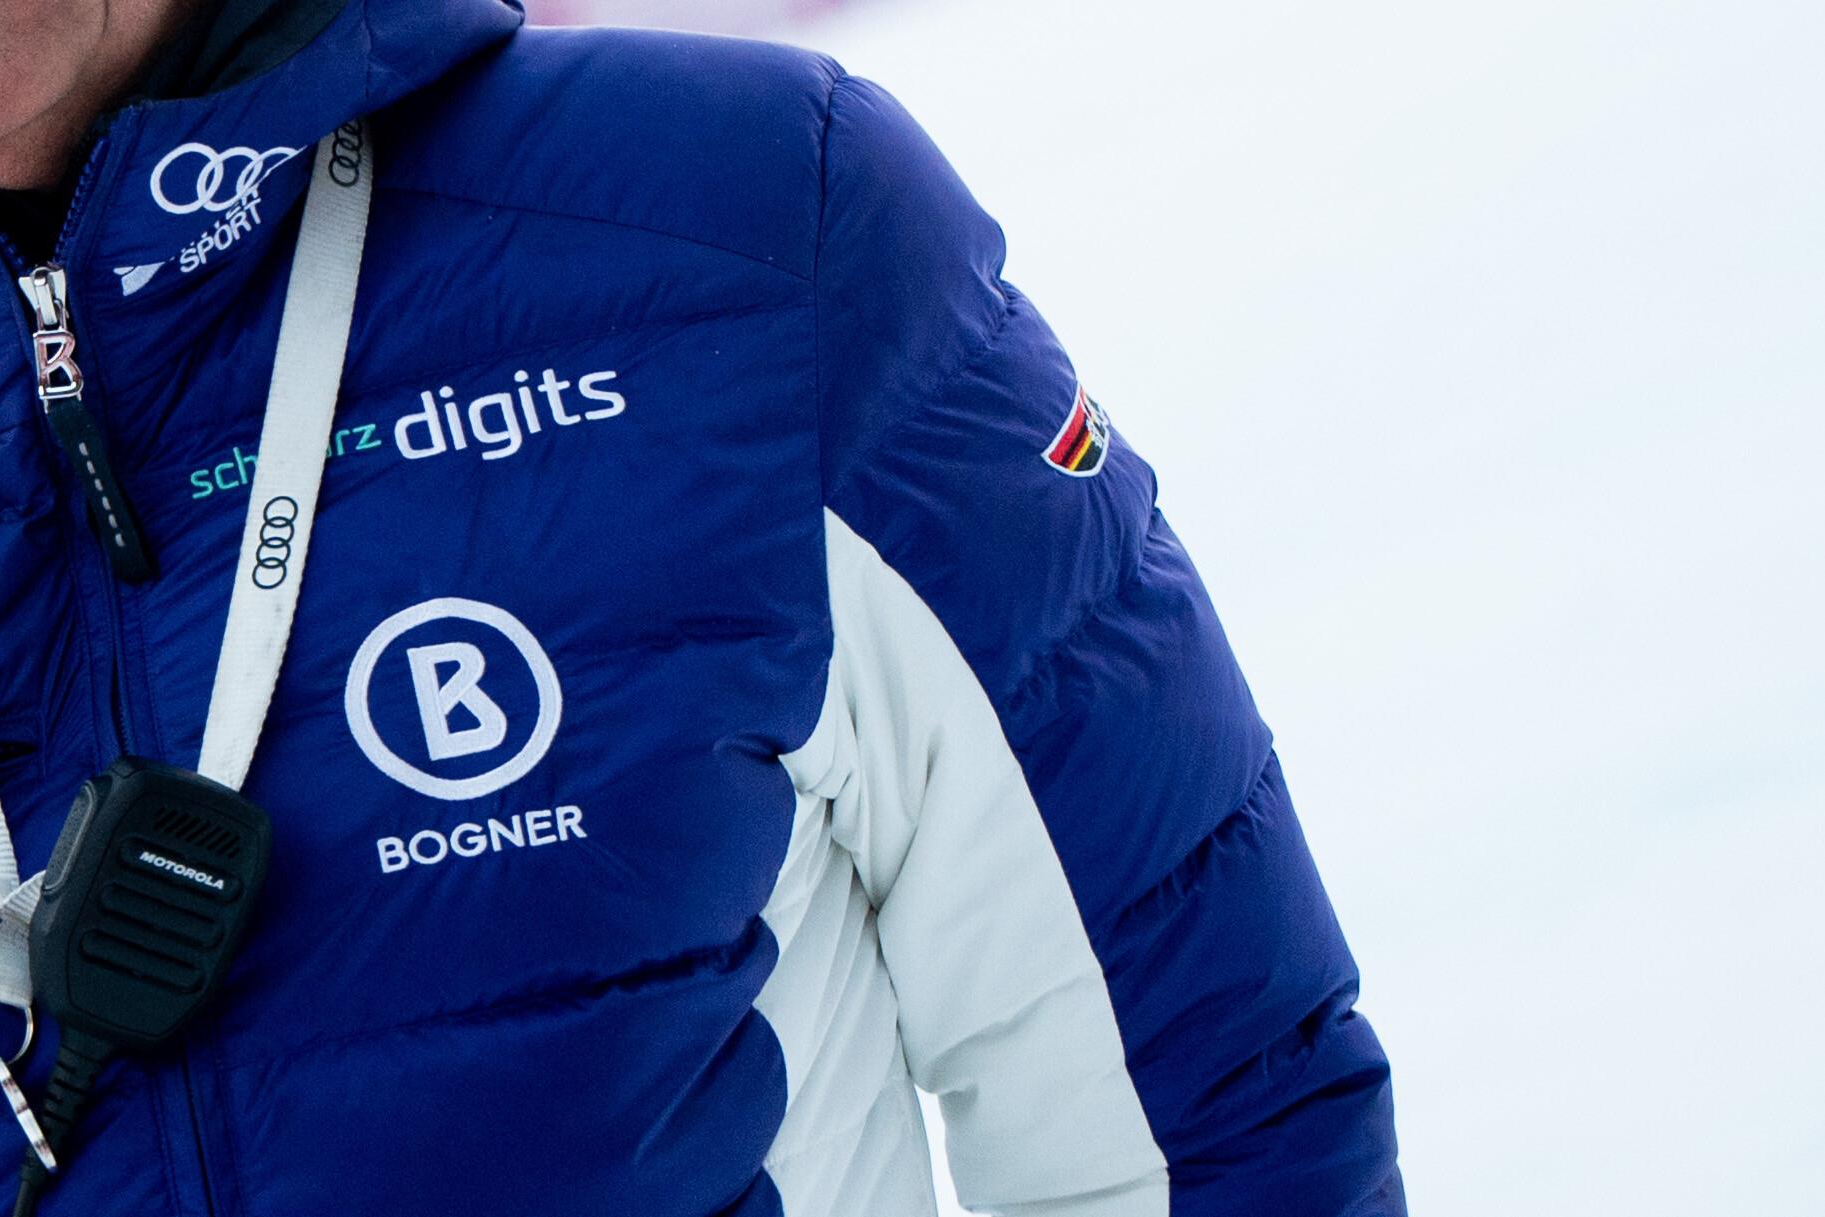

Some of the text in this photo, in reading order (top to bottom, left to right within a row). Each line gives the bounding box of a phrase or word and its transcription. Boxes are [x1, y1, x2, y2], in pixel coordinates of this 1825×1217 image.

[179, 197, 262, 273] SPORT
[190, 368, 626, 499] schrz digits
[139, 851, 224, 890] MOTOROLA
[376, 804, 588, 874] BOGNER
